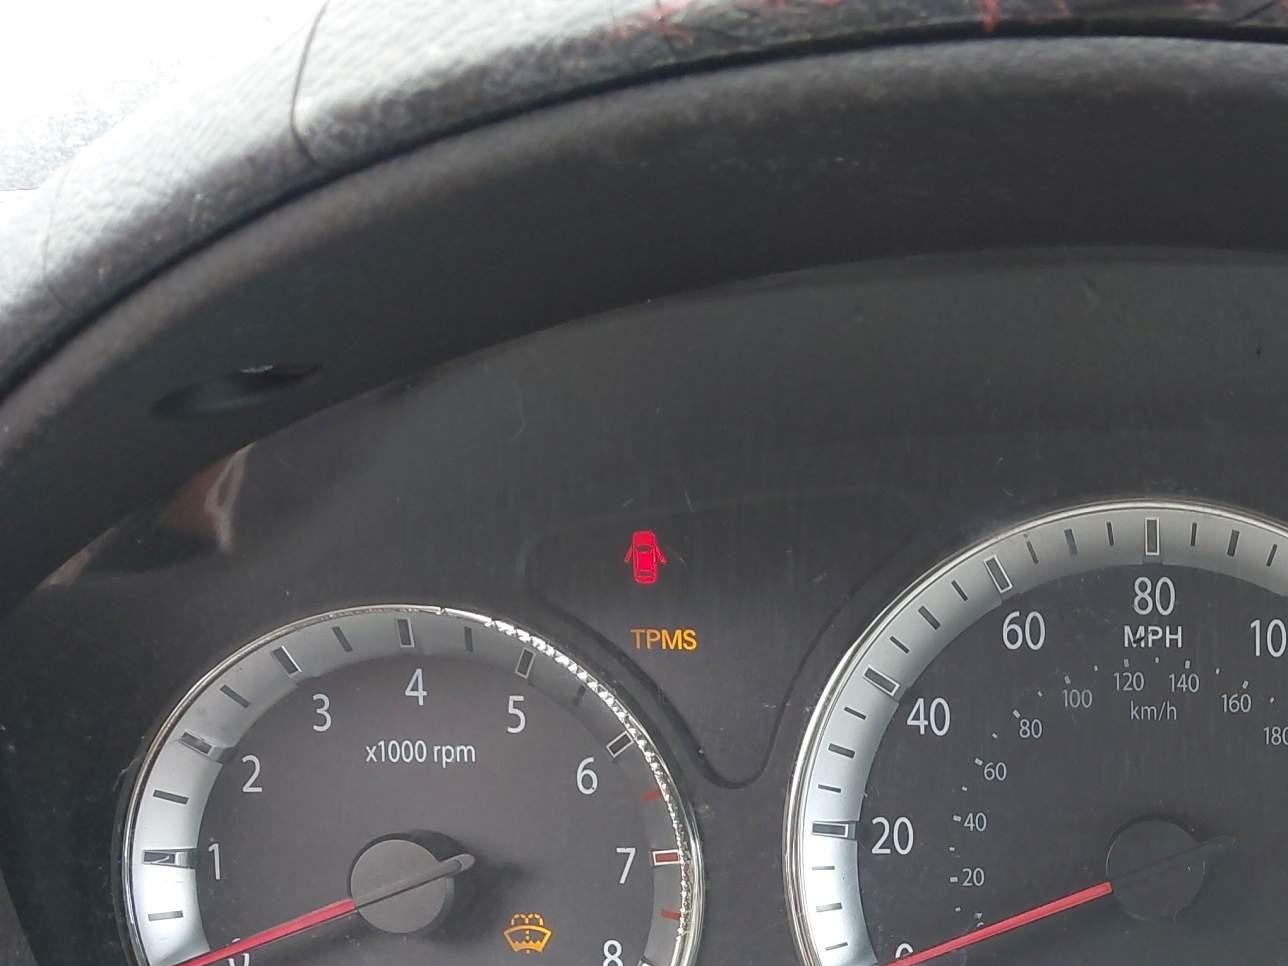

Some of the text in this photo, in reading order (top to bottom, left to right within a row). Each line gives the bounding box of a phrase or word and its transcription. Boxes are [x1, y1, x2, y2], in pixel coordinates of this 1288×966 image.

[1134, 577, 1175, 615] 80
[631, 630, 697, 651] TPMS
[1003, 612, 1045, 650] 60
[1125, 626, 1181, 647] MPH
[405, 669, 427, 705] 4
[1114, 672, 1144, 691] 120
[1170, 674, 1199, 692] 140
[313, 694, 331, 731] 3
[1064, 690, 1092, 708] 100
[1131, 701, 1176, 720] km/h
[1222, 694, 1251, 712] 160
[508, 696, 525, 733] 5
[907, 698, 950, 735] 40
[1020, 719, 1042, 738] 80
[366, 741, 475, 768] x1000 rpm
[242, 755, 262, 792] 2
[577, 758, 597, 794] 6
[984, 763, 1006, 780] 60
[872, 817, 913, 854] 20
[964, 813, 986, 831] 40
[209, 844, 220, 879] 1
[617, 848, 635, 883] 7
[963, 868, 984, 886] 20
